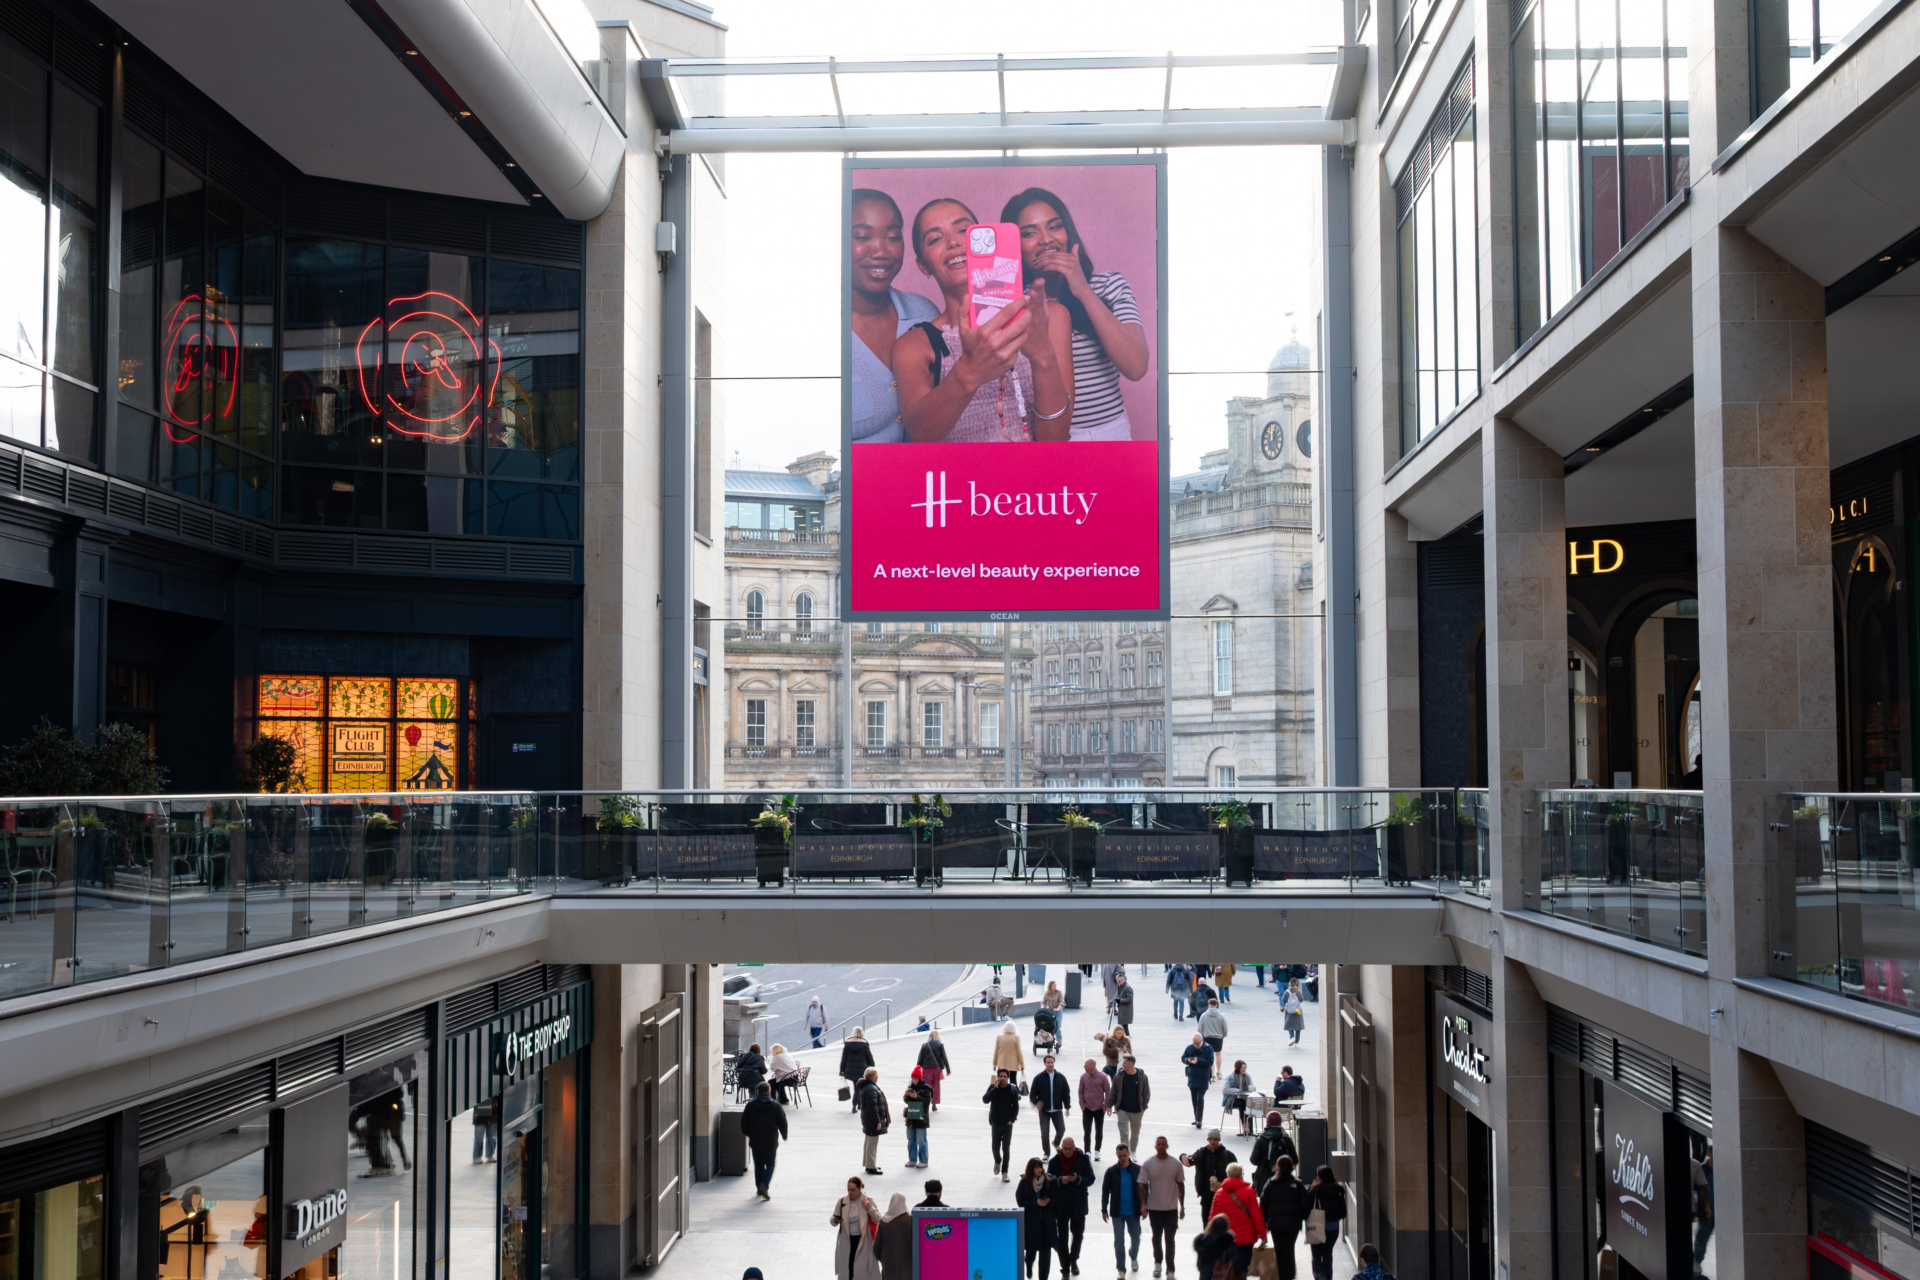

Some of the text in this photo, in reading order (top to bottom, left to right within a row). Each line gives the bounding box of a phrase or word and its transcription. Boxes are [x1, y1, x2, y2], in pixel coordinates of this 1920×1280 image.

[986, 261, 1019, 278] beauty
[967, 481, 1098, 525] beauty
[1569, 539, 1624, 575] HD
[873, 562, 1140, 581] A next-level beauty experience
[990, 612, 1020, 620] OCEAN
[338, 729, 381, 740] FLIGHT
[345, 740, 375, 751] CLUB
[337, 761, 382, 770] EDINBURGH
[678, 855, 718, 863] EDINBURGH
[830, 855, 873, 863] EDINBURGH
[1136, 855, 1180, 863] EDINBURGH
[519, 1015, 570, 1061] THE BODY SHOP
[1612, 1133, 1654, 1201] Kiehl's
[294, 1188, 347, 1241] Dune
[1620, 1209, 1635, 1228] SINCE
